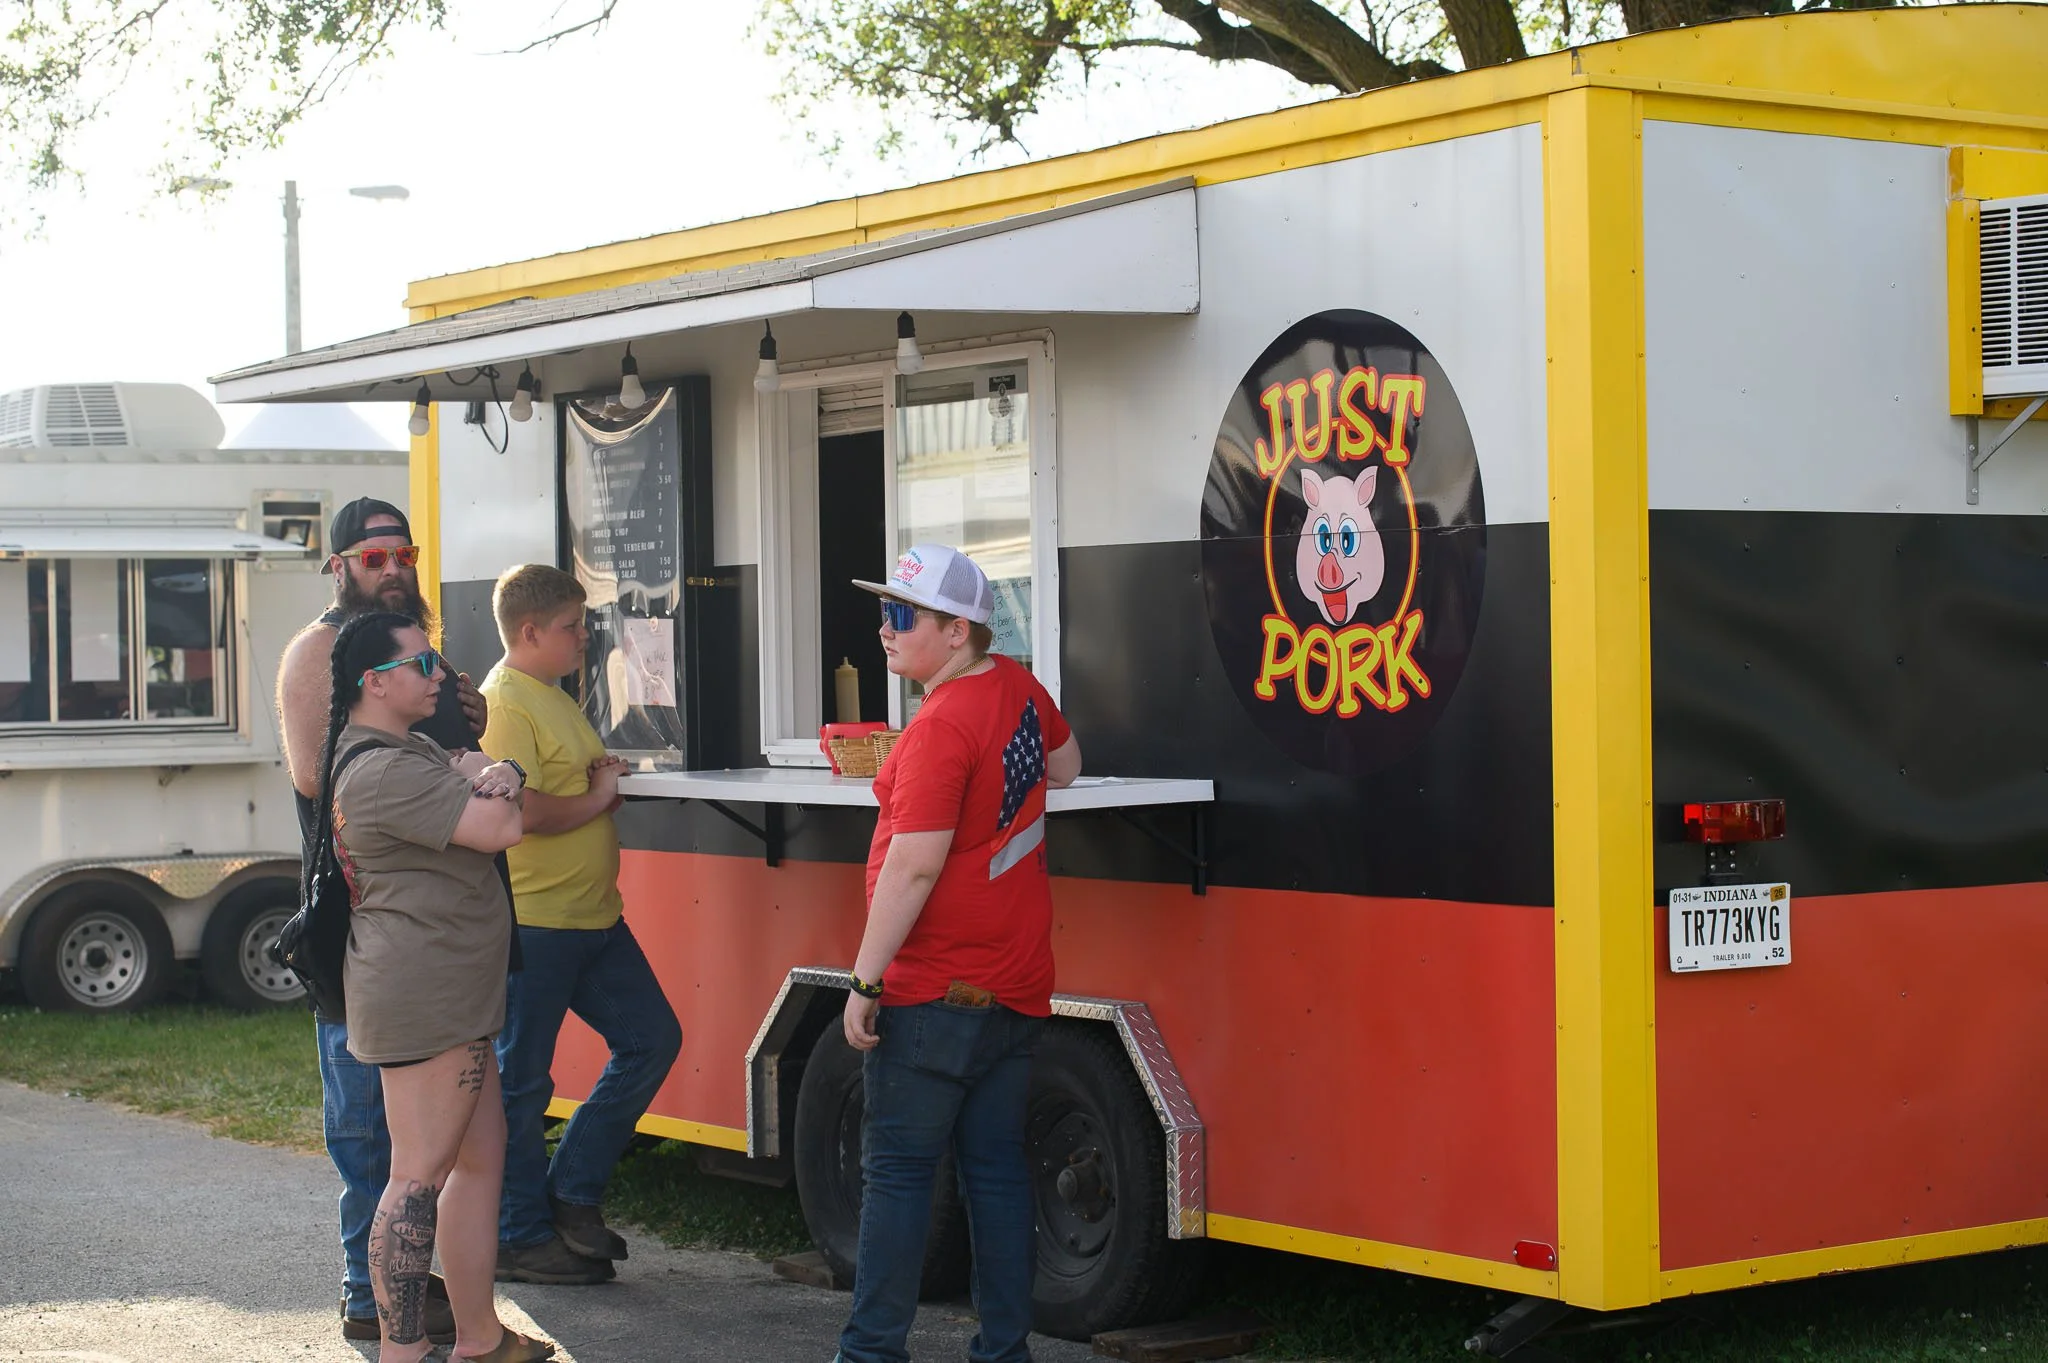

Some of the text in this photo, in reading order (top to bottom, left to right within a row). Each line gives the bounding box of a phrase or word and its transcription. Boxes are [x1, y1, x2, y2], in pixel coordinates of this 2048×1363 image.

[1255, 366, 1426, 480] JUST
[630, 510, 645, 519] BLEU
[615, 528, 629, 537] CHOP
[593, 545, 616, 554] GRILLED
[618, 559, 636, 569] SALAD
[621, 570, 637, 579] SALAD
[1255, 609, 1432, 718] PORK
[1672, 892, 1692, 903] 01-31
[1703, 889, 1758, 902] INDIANA
[1682, 906, 1780, 947] TR773KYG
[1771, 947, 1785, 958] 52
[1713, 954, 1735, 962] TRAILER
[400, 1226, 414, 1237] LAS
